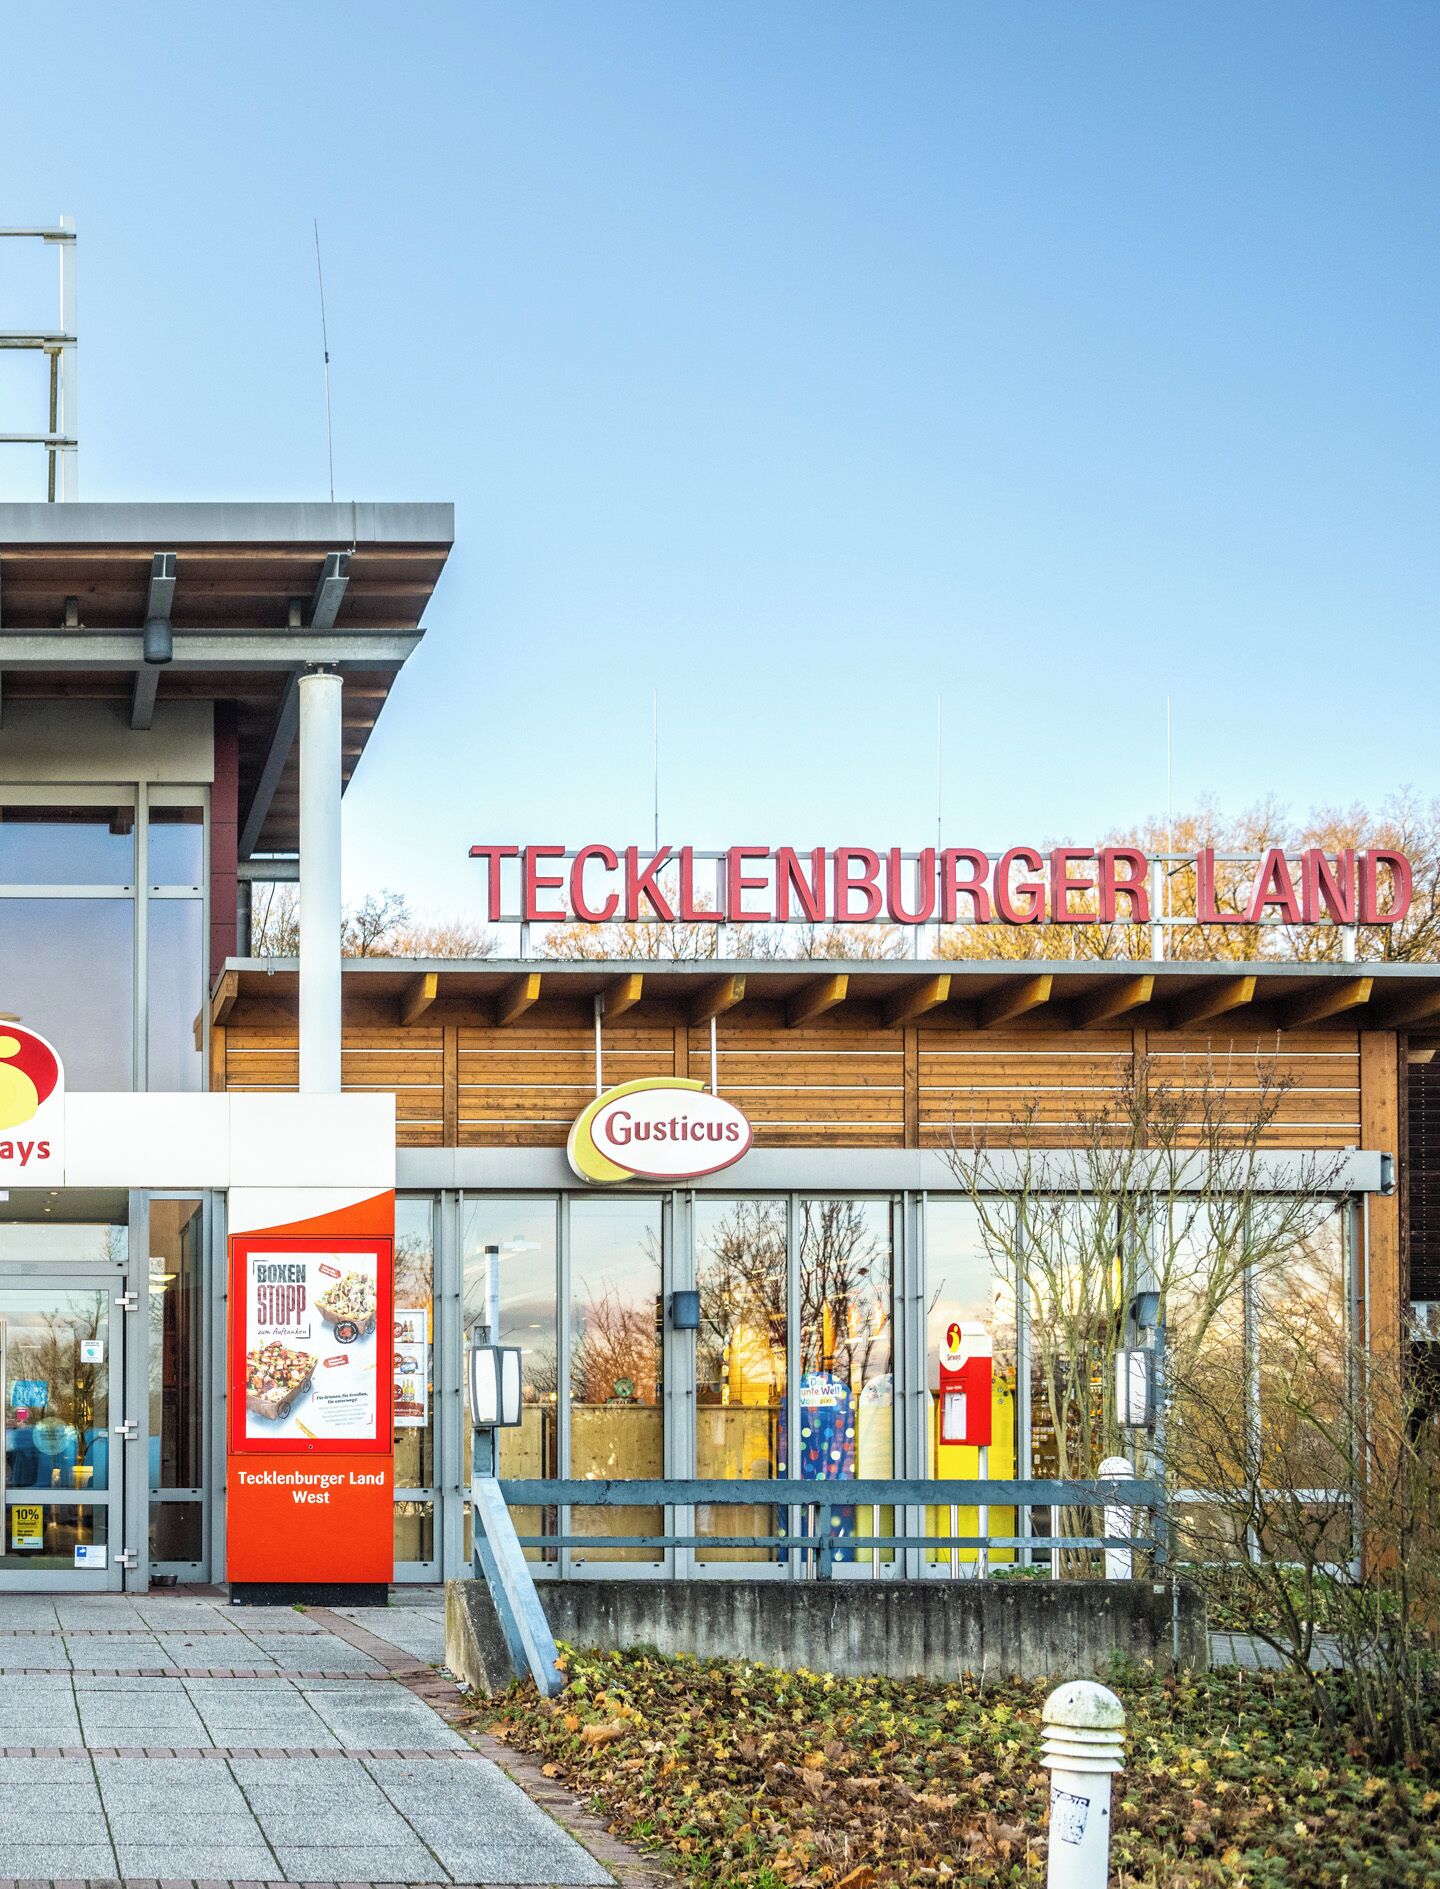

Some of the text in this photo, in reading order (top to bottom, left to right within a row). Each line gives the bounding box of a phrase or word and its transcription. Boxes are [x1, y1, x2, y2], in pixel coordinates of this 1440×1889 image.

[468, 844, 1414, 926] TECKLENBURGER LAND
[604, 1110, 740, 1146] Gusticus
[257, 1264, 306, 1283] BOXEN
[257, 1284, 306, 1326] STOPP
[273, 1327, 307, 1336] Auftanken
[800, 1385, 841, 1396] unte Welt
[238, 1471, 385, 1489] Tecklenburger Land
[292, 1490, 330, 1504] West
[16, 1509, 39, 1520] 10%
